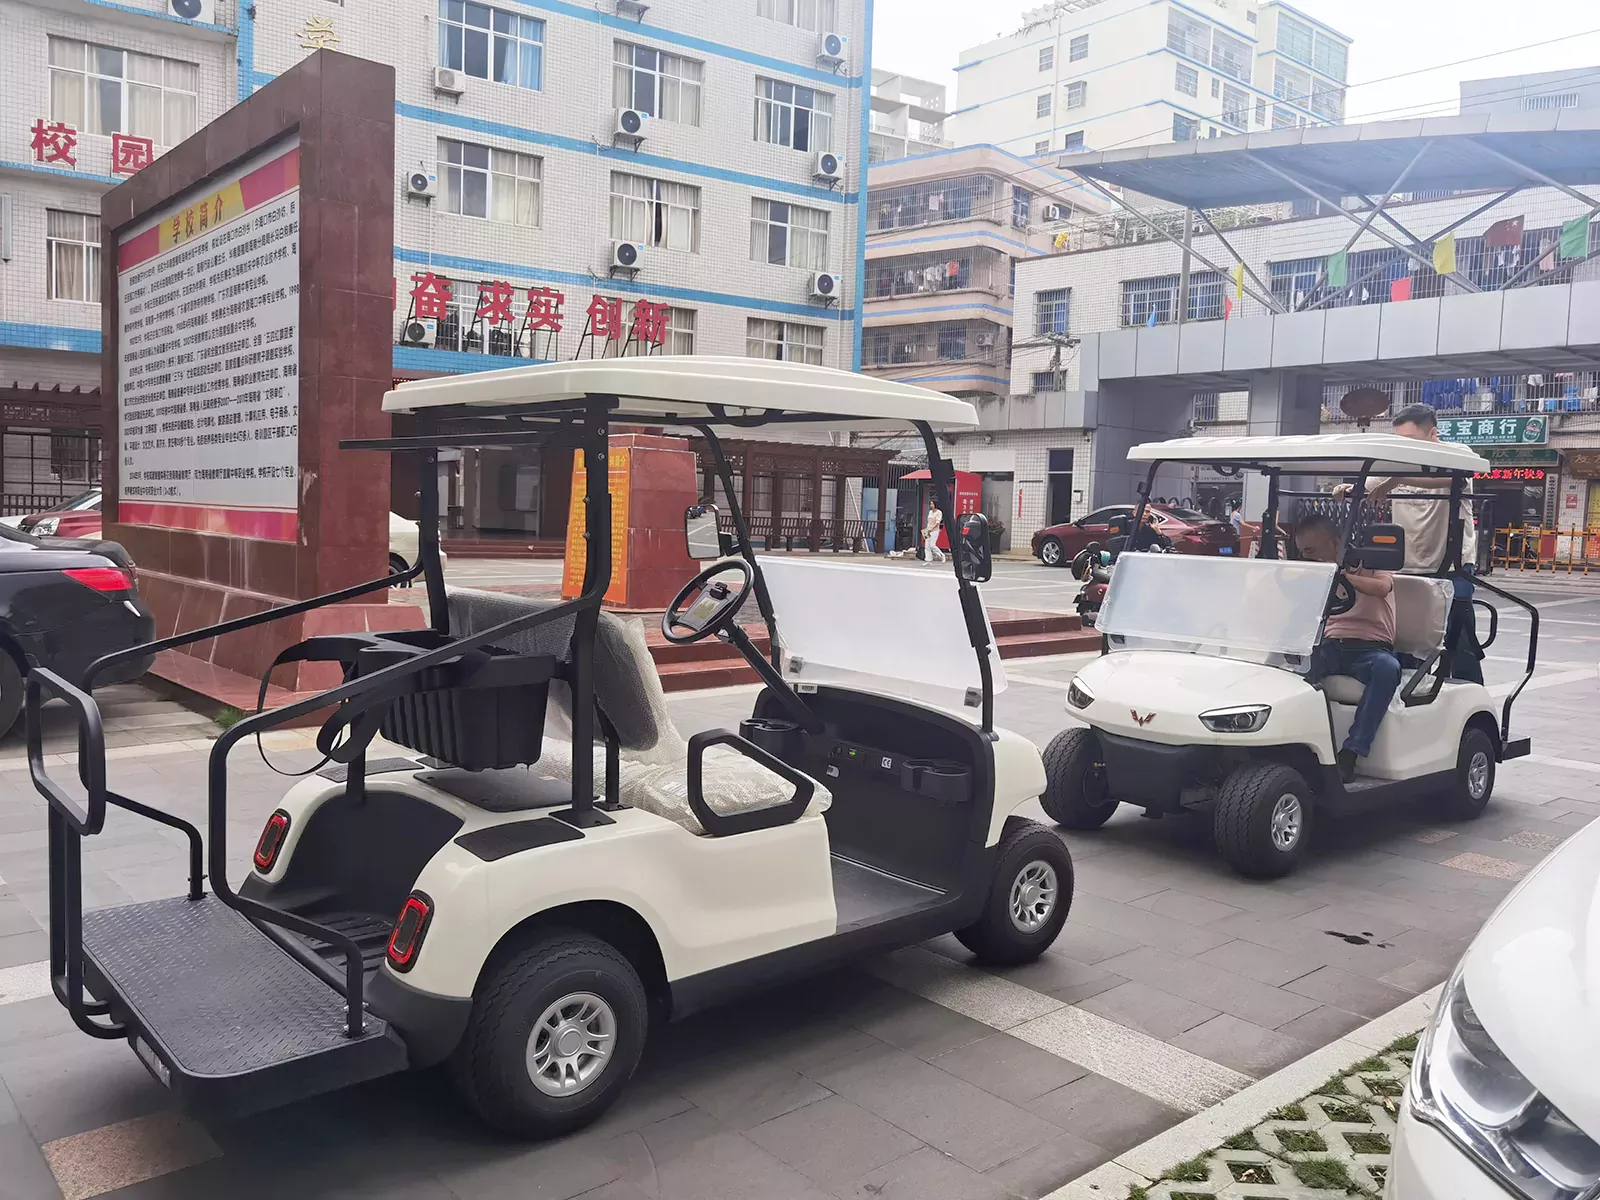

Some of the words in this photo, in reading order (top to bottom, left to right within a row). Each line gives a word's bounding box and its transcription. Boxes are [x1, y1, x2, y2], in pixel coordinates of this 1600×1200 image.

[30, 118, 154, 174] 校园
[172, 194, 224, 245] 学校简介
